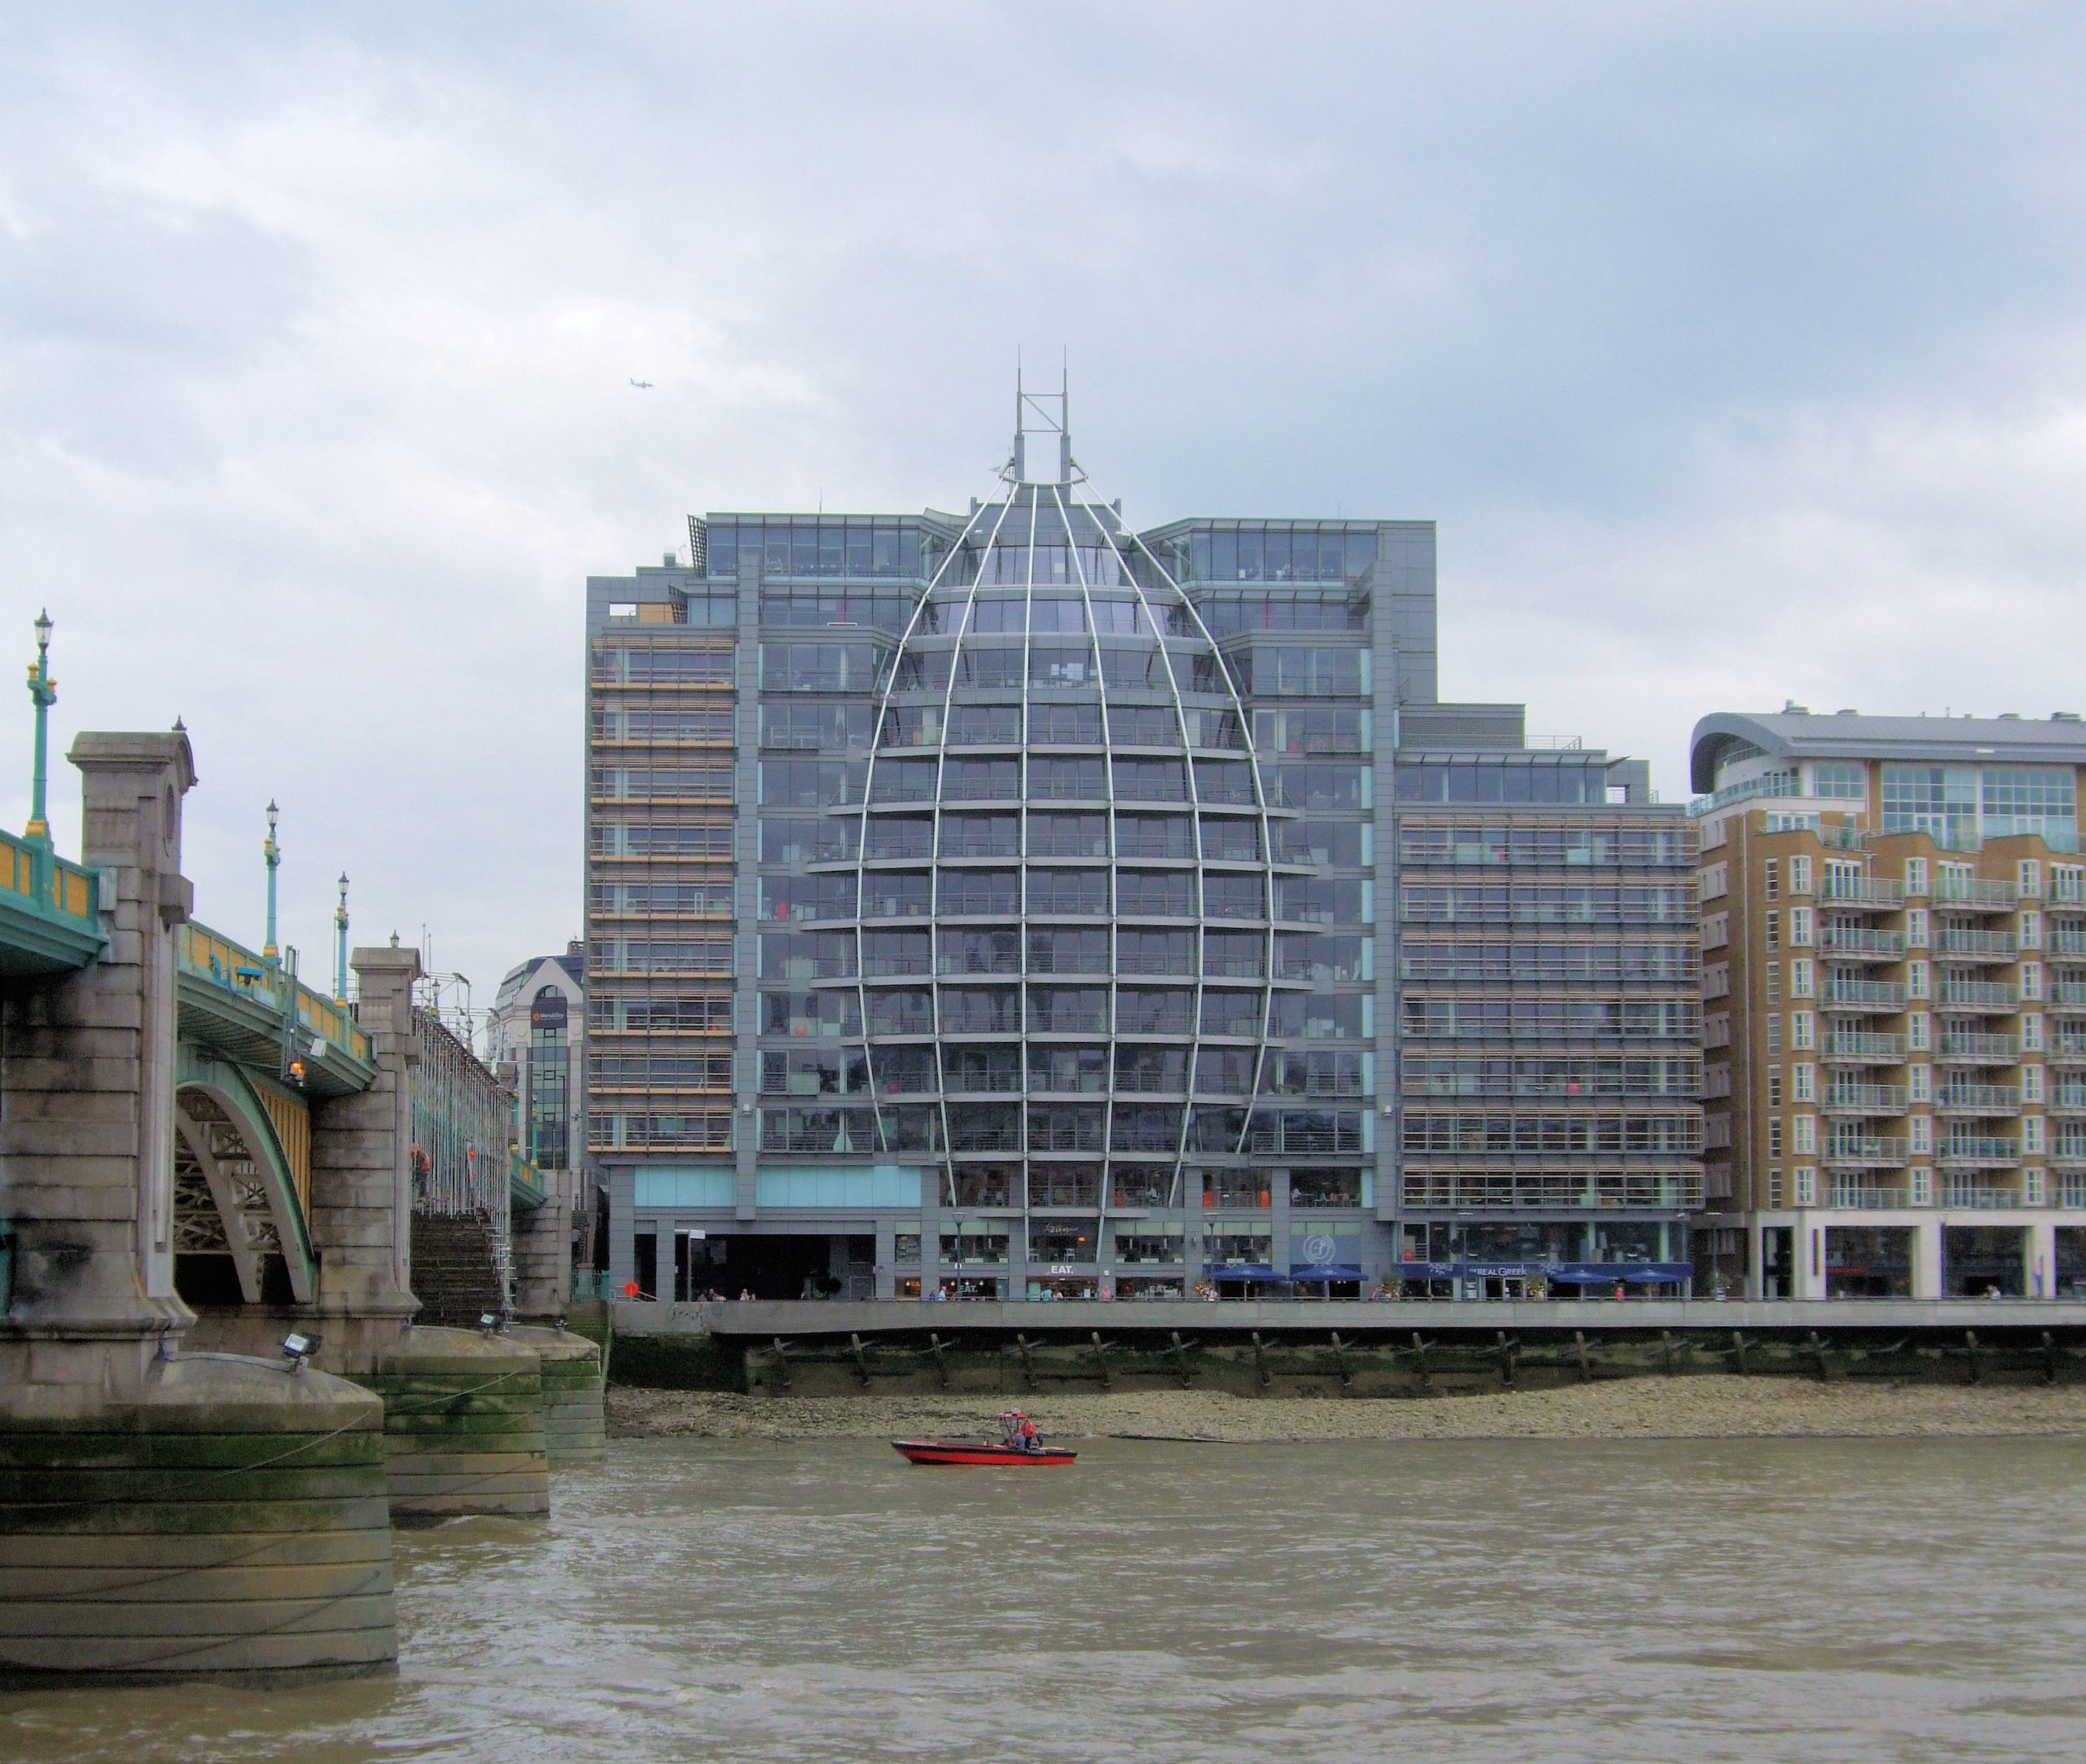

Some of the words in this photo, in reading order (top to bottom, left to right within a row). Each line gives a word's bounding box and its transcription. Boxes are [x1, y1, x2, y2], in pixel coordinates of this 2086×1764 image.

[1051, 1265, 1074, 1274] EAT.
[1477, 1268, 1498, 1276] REAL
[1498, 1265, 1527, 1276] GREEK
